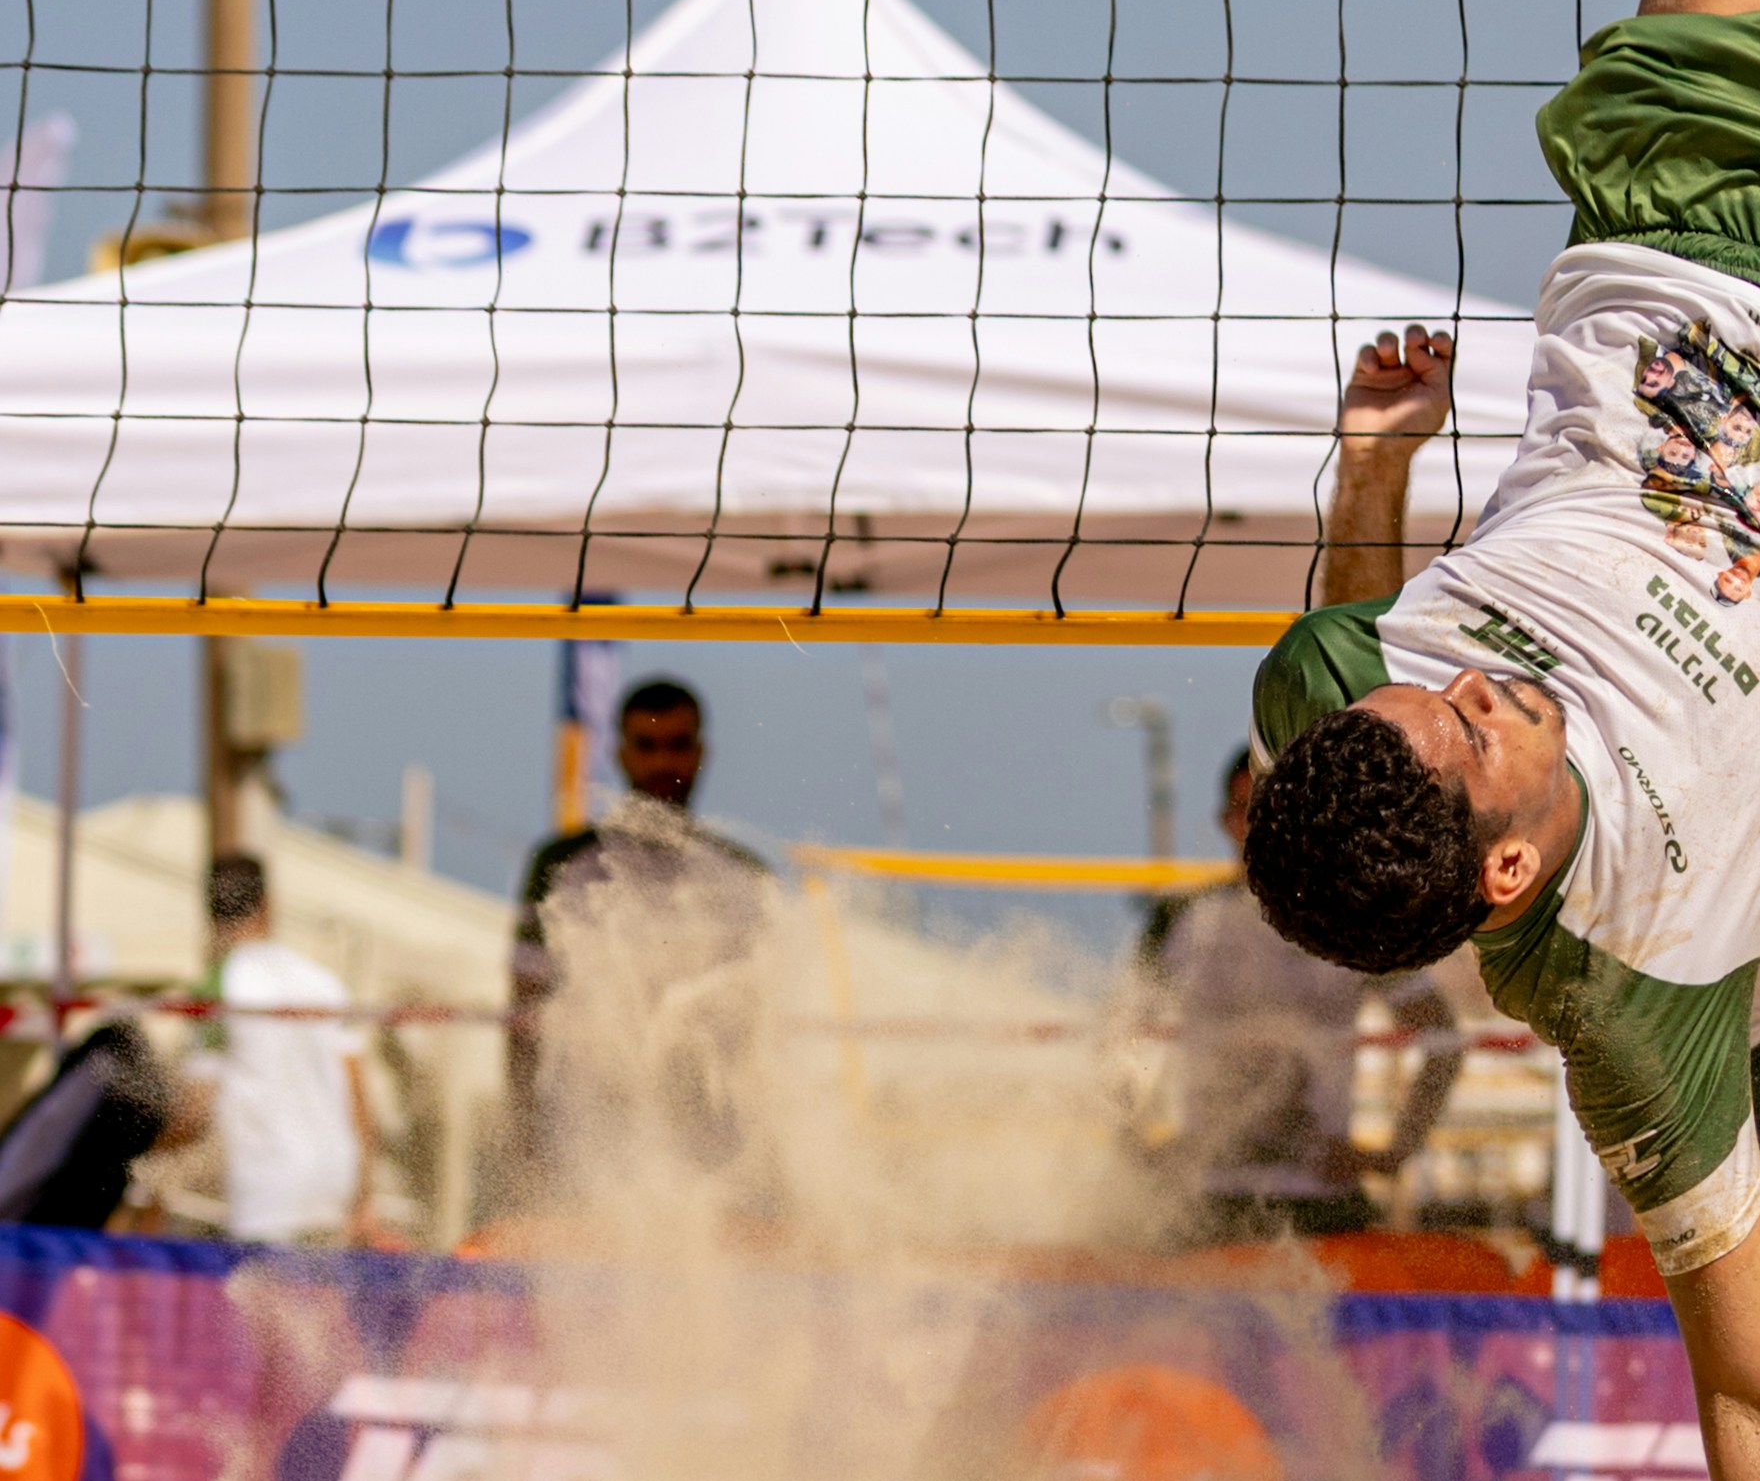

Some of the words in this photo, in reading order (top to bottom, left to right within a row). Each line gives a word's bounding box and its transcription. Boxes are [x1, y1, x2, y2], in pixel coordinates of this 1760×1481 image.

[580, 207, 1131, 261] B2Tech
[1635, 612, 1718, 705] טורניר
[1646, 574, 1760, 697] גיבורים
[1618, 746, 1676, 836] STORMO
